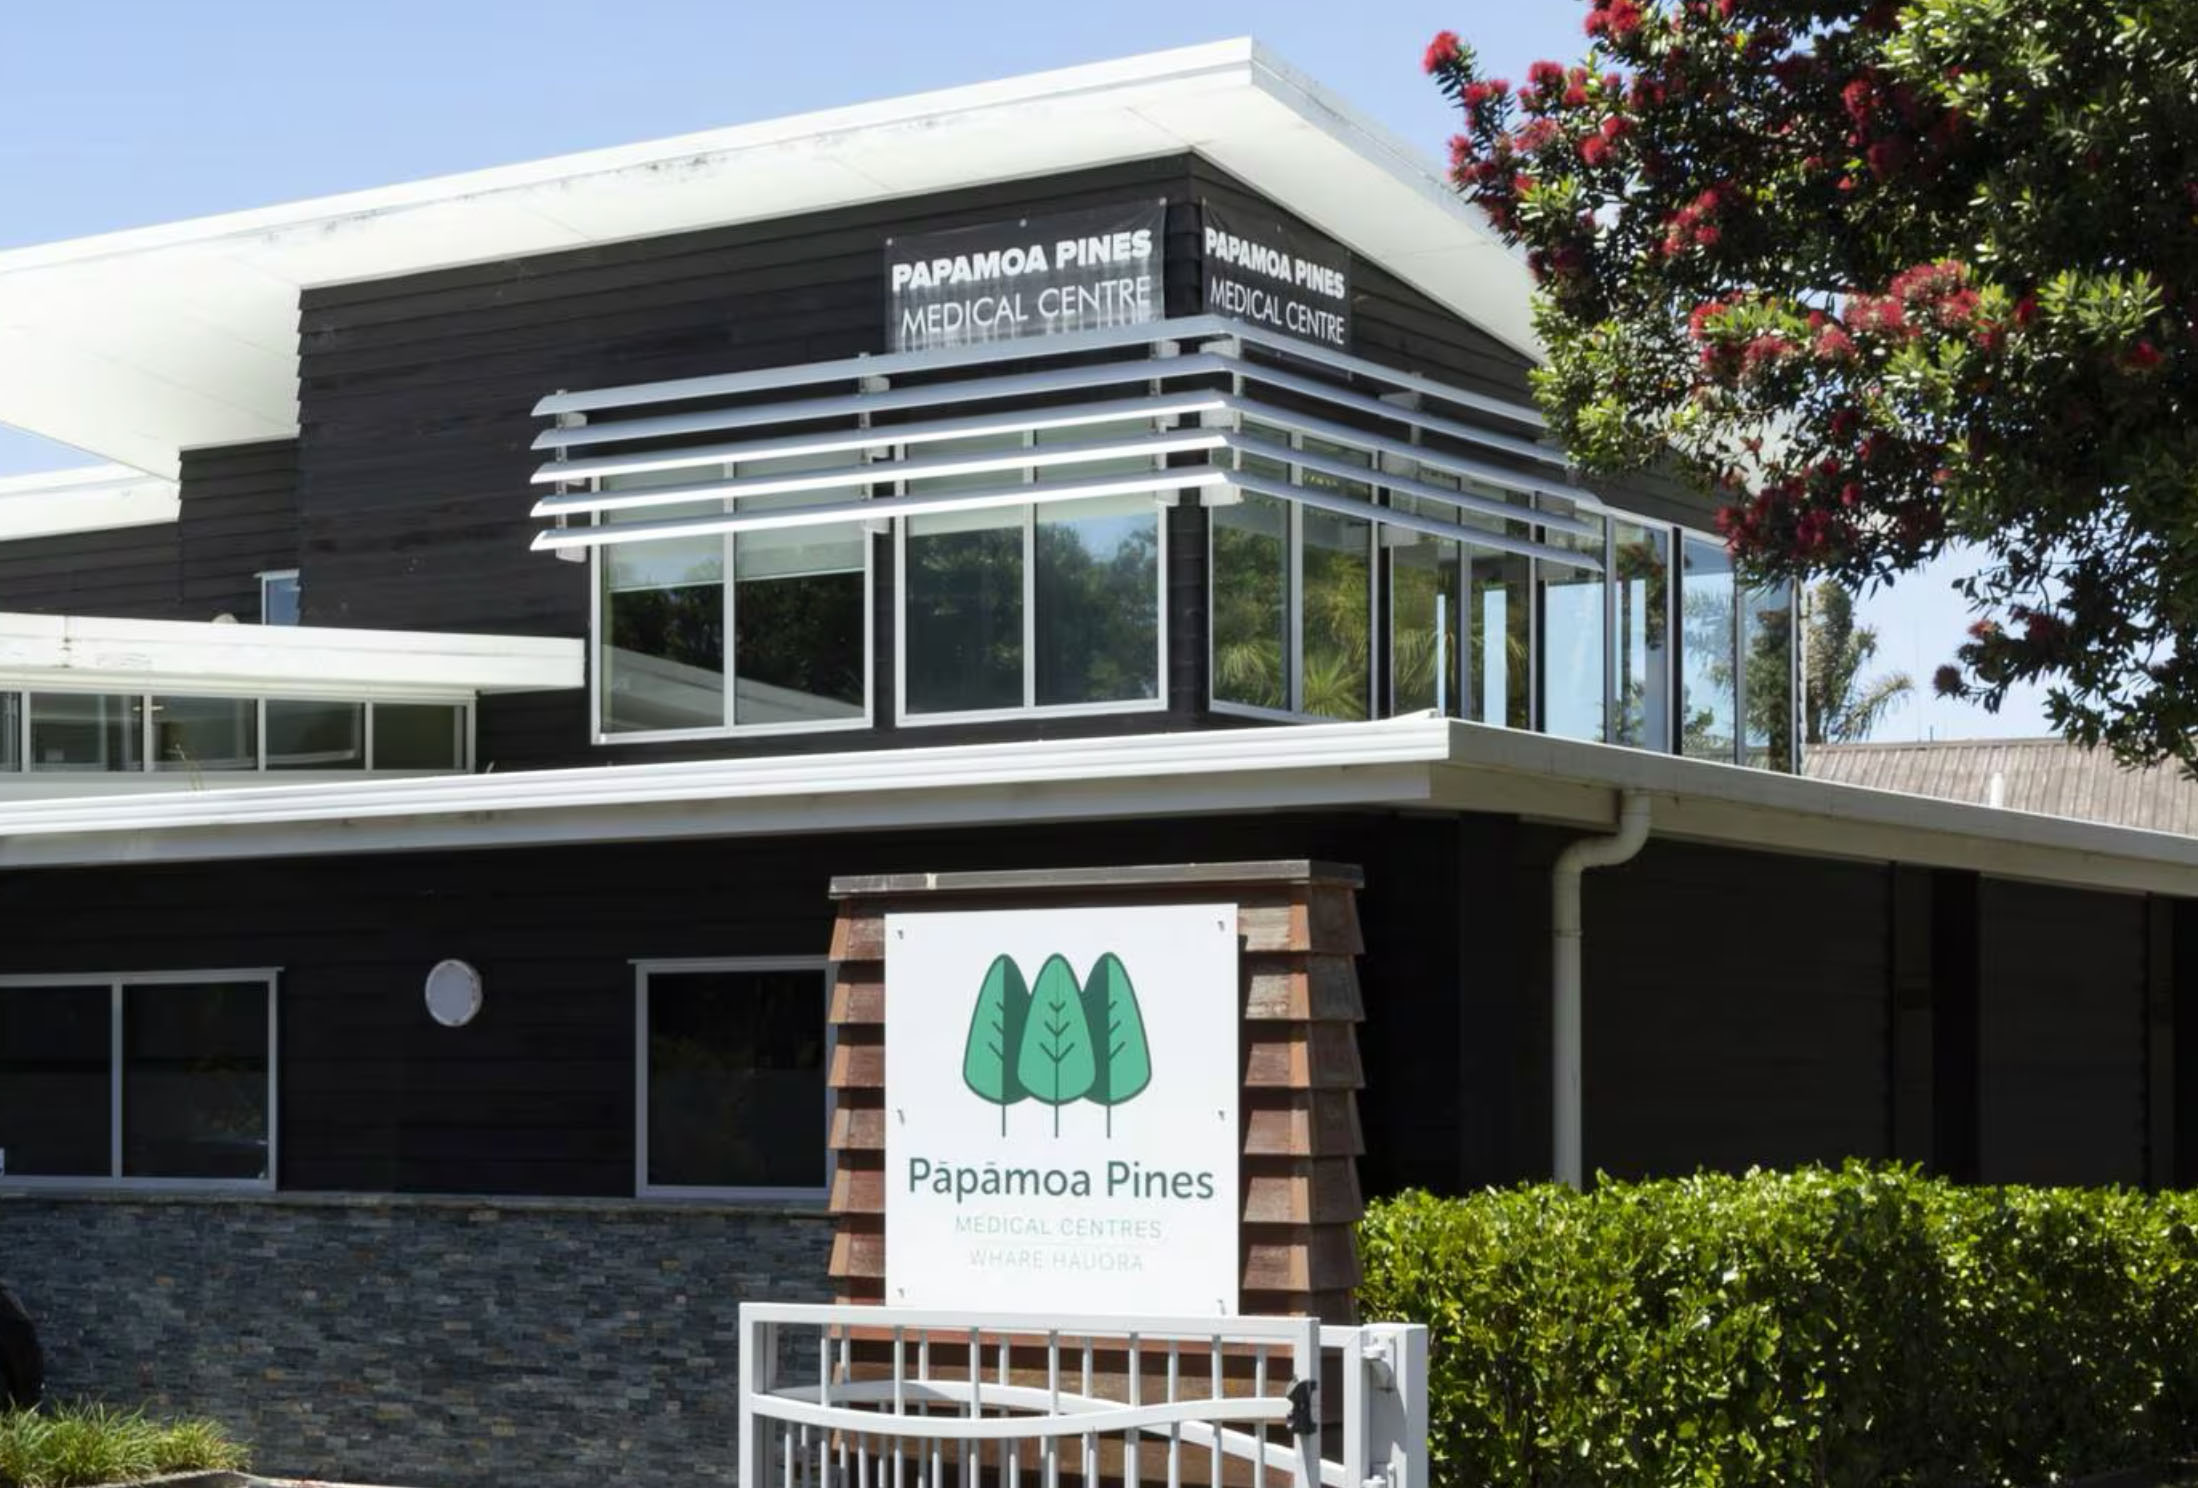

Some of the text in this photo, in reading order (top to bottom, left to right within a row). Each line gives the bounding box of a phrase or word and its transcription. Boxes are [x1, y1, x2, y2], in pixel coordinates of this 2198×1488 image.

[892, 228, 1153, 292] PAPAMOA PINES
[1205, 227, 1346, 300] PAPAMOA PINES
[900, 276, 1152, 338] MEDICAL CENTRE
[1210, 276, 1346, 346] MEDICAL CENTRE
[908, 1157, 1215, 1204] Pāpāmoa Pines
[955, 1214, 1163, 1240] MEDICAL CENTRES
[969, 1248, 1144, 1273] WHARE HAUORA
